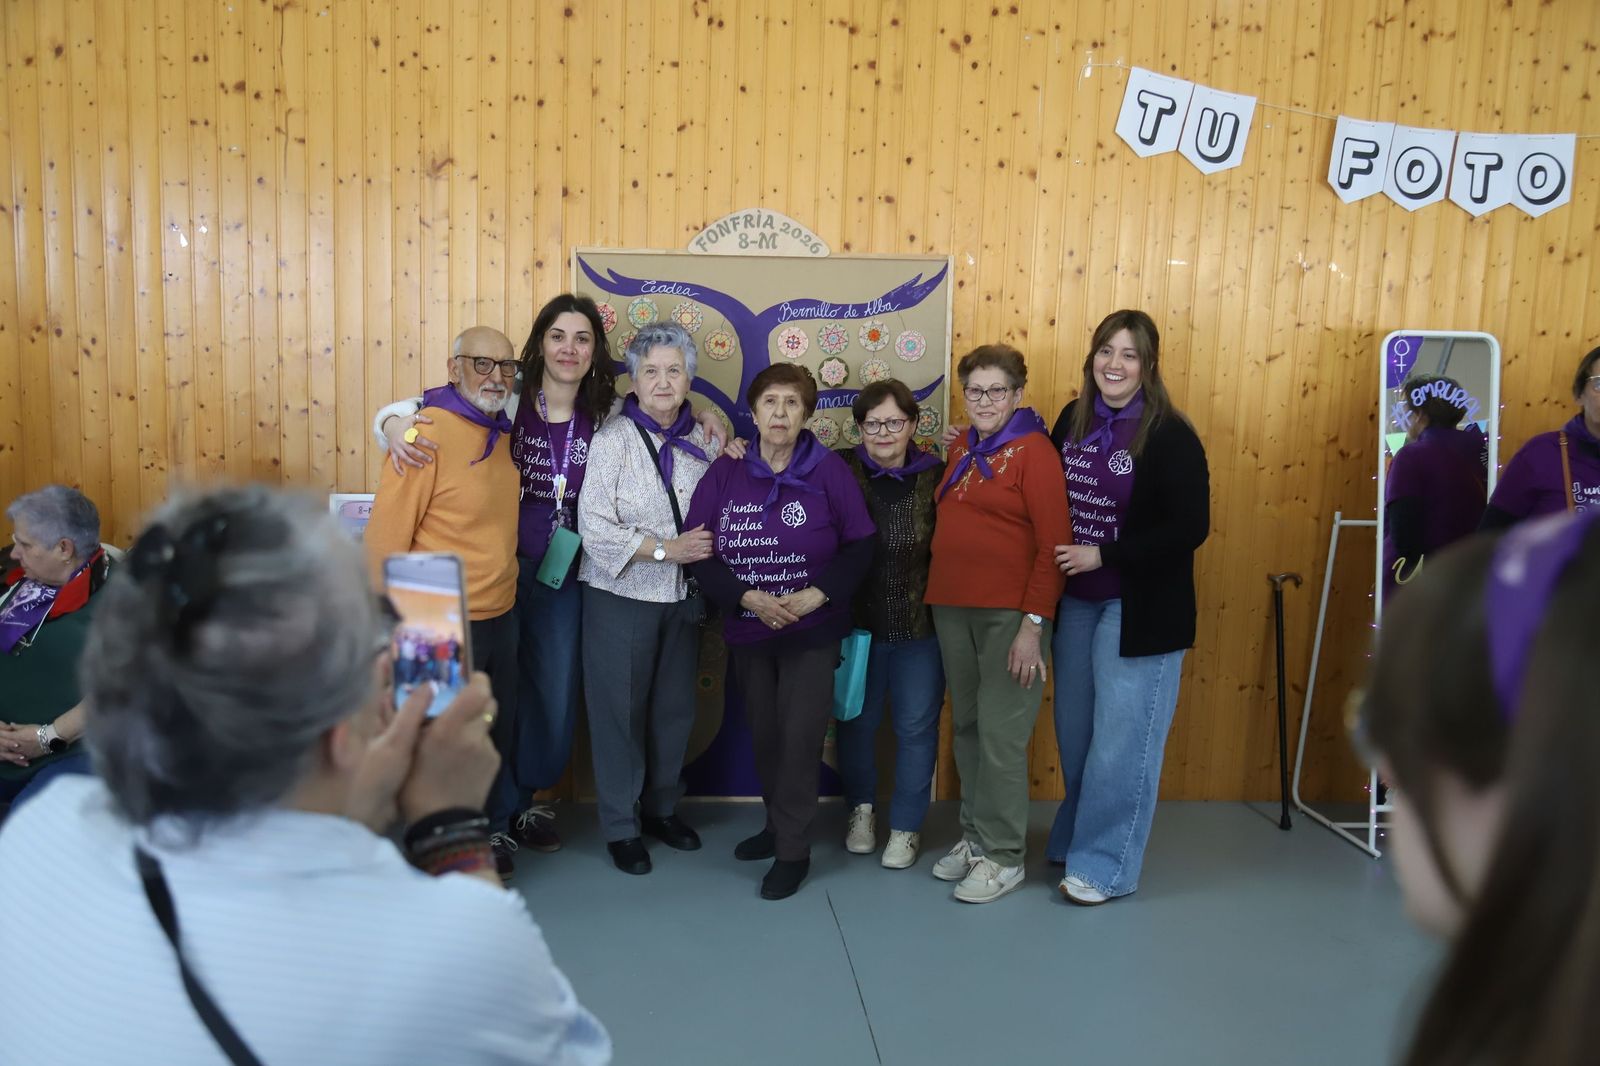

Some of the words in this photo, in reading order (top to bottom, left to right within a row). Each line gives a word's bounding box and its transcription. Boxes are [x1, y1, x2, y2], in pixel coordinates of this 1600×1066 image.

[1137, 89, 1240, 164] TU
[1338, 137, 1566, 206] FOTO
[738, 232, 779, 249] 8-M
[780, 222, 822, 254] 2026
[778, 301, 842, 324] Bermillo
[843, 304, 859, 318] de
[864, 298, 900, 316] Alba
[722, 500, 764, 514] Juntas
[719, 515, 763, 532] Unidas
[719, 533, 779, 551] Poderosas
